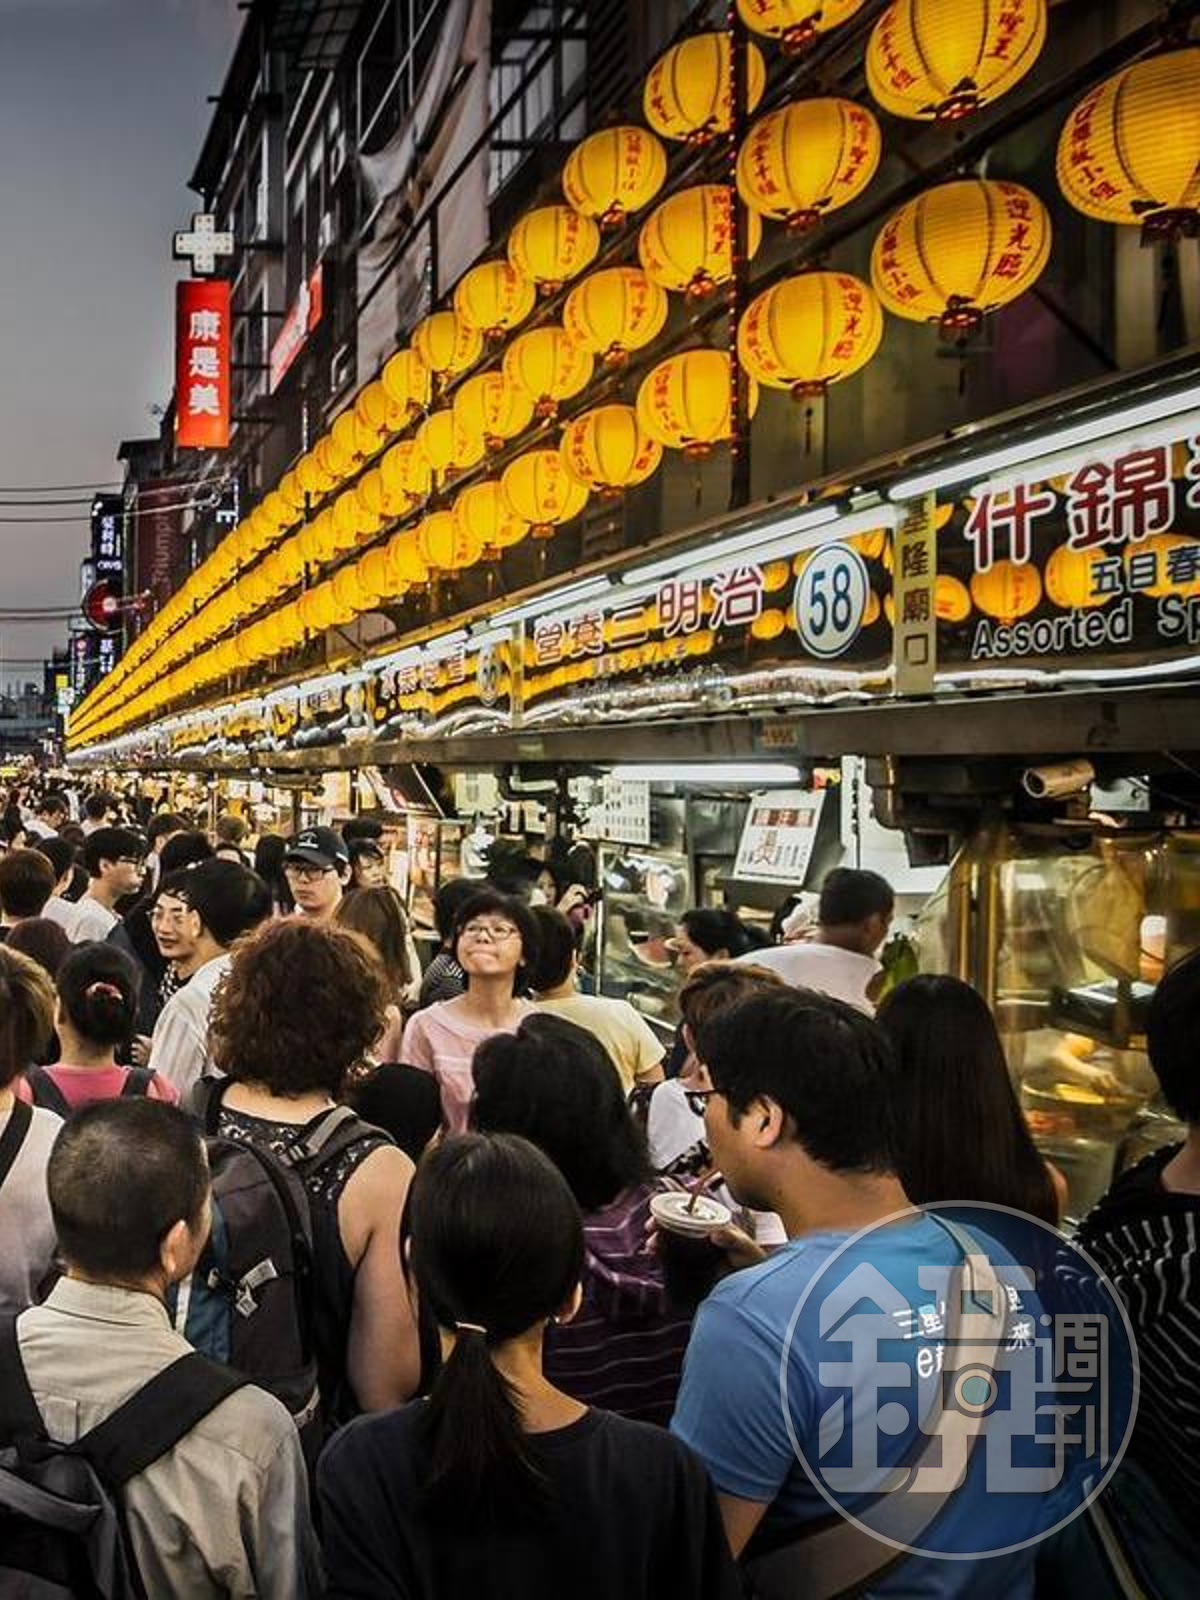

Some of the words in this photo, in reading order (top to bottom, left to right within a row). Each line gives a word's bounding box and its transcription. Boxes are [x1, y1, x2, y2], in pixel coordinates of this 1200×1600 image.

[188, 310, 222, 417] 康是美
[964, 436, 1200, 573] 什錦
[807, 562, 852, 637] 58
[972, 601, 1132, 660] Assorted
